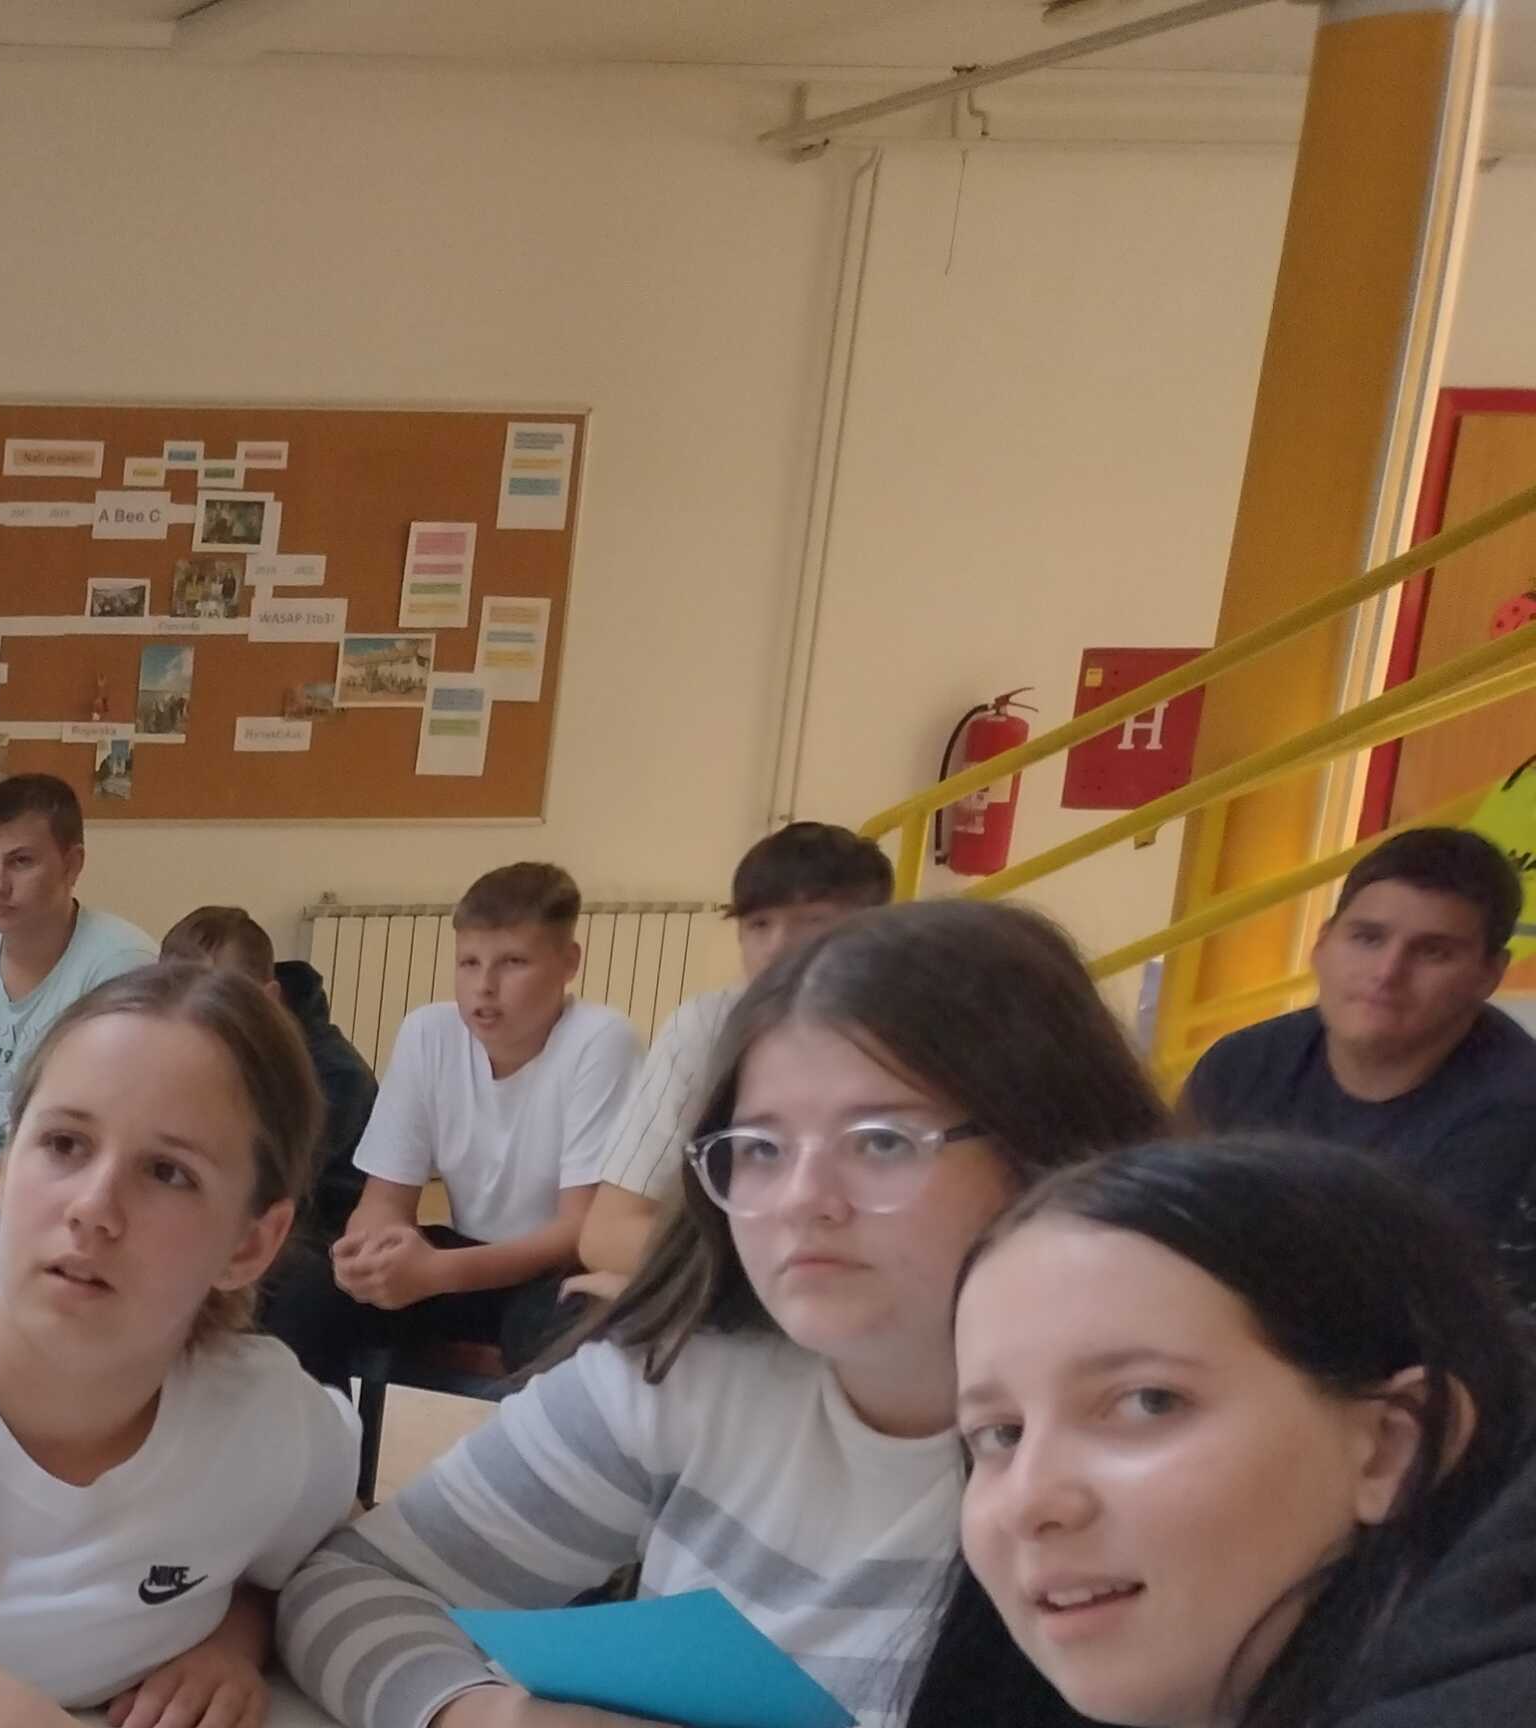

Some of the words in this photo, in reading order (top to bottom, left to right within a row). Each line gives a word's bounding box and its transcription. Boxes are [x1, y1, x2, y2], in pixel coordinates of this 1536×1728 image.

[98, 509, 109, 523] A
[149, 508, 161, 523] C
[1118, 700, 1169, 750] H
[148, 1565, 190, 1587] NIKE
